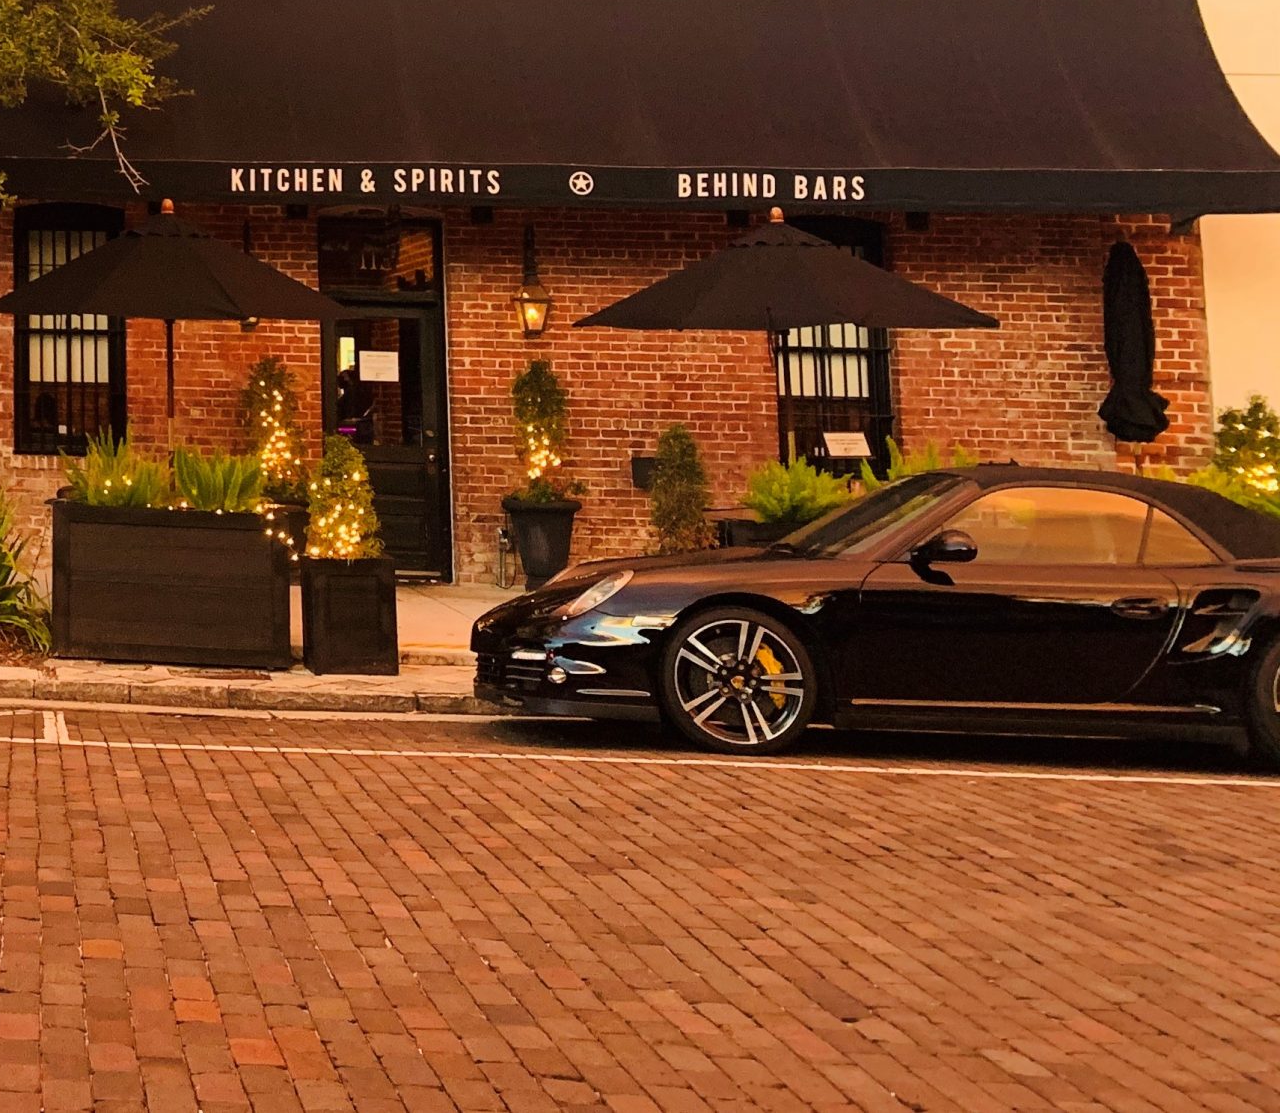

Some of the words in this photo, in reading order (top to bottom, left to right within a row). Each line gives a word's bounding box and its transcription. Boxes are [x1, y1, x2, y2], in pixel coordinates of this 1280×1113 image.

[230, 168, 343, 193] KITCHEN
[360, 168, 376, 193] &
[394, 169, 501, 195] SPIRITS
[678, 173, 776, 198] BEHIND
[794, 175, 866, 201] BARS
